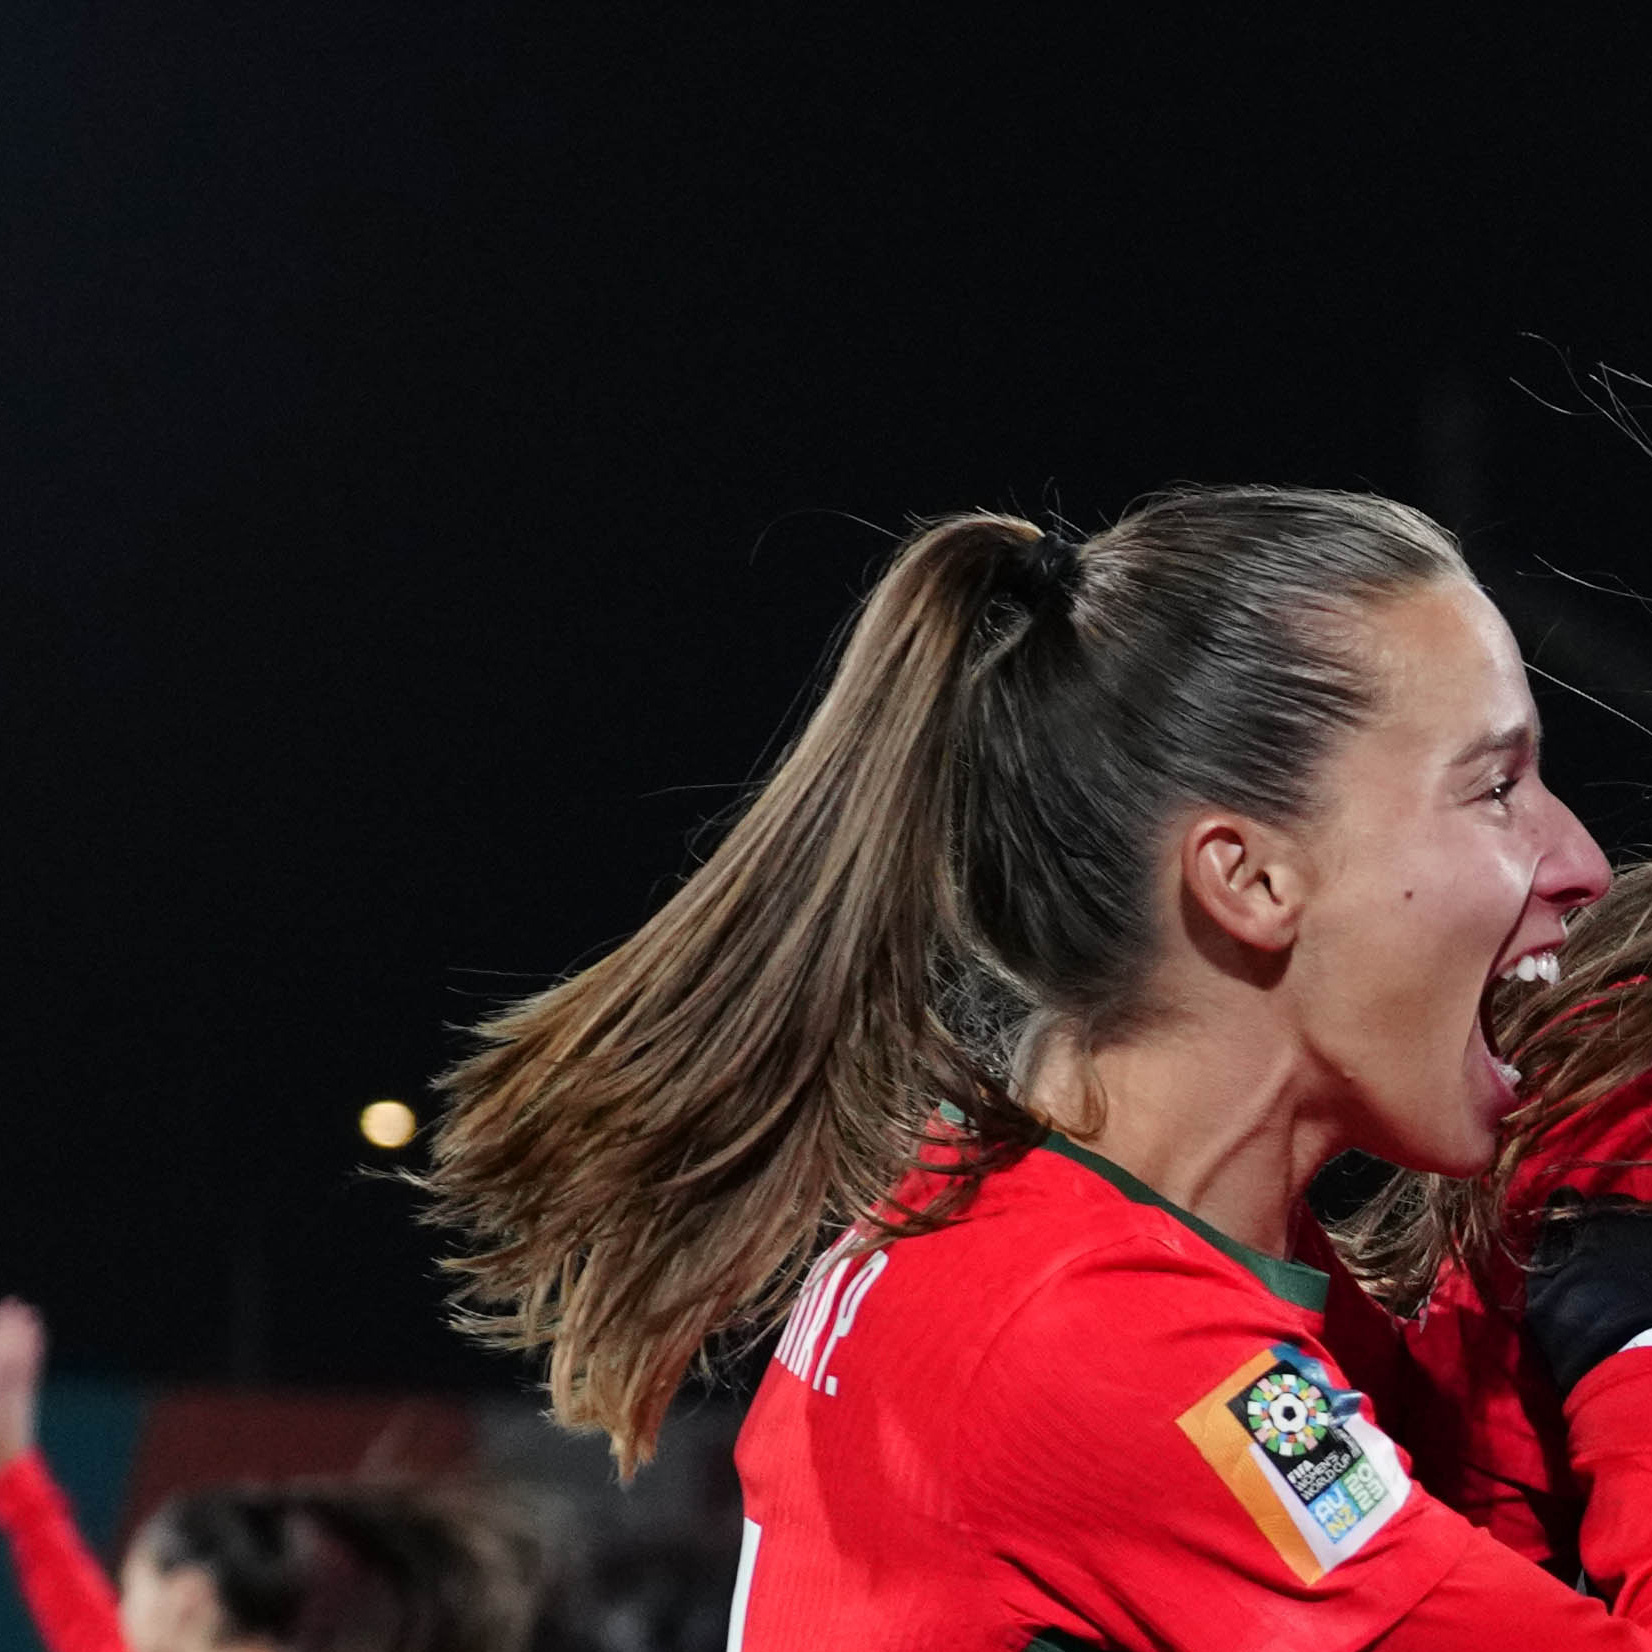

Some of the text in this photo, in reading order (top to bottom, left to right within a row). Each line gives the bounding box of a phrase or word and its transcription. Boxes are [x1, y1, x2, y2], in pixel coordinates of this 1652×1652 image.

[1286, 1459, 1314, 1483] FIFA
[1300, 1453, 1352, 1501] WORLD CUP
[1314, 1487, 1346, 1522] AU
